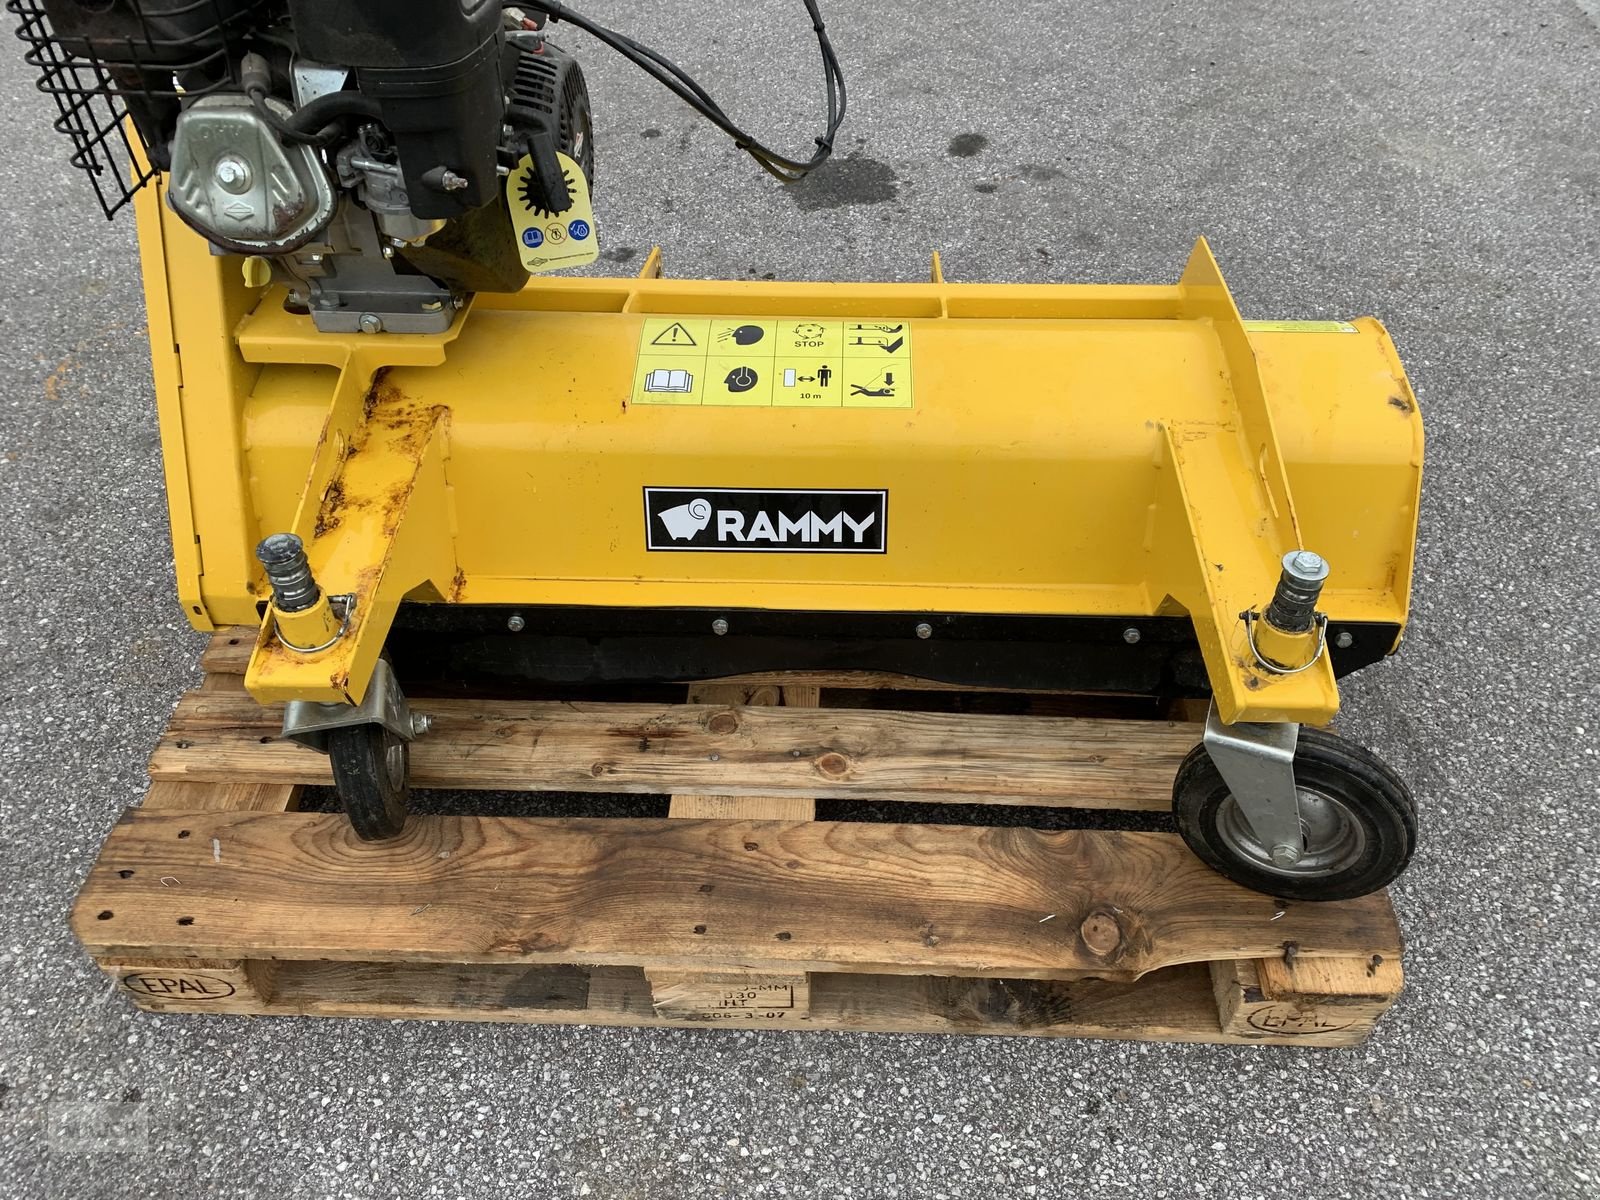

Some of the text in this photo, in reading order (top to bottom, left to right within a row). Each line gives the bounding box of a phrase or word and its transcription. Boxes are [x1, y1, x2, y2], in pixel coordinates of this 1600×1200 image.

[794, 340, 825, 348] STOP
[717, 509, 875, 543] RAMMY
[139, 977, 220, 994] EPAL
